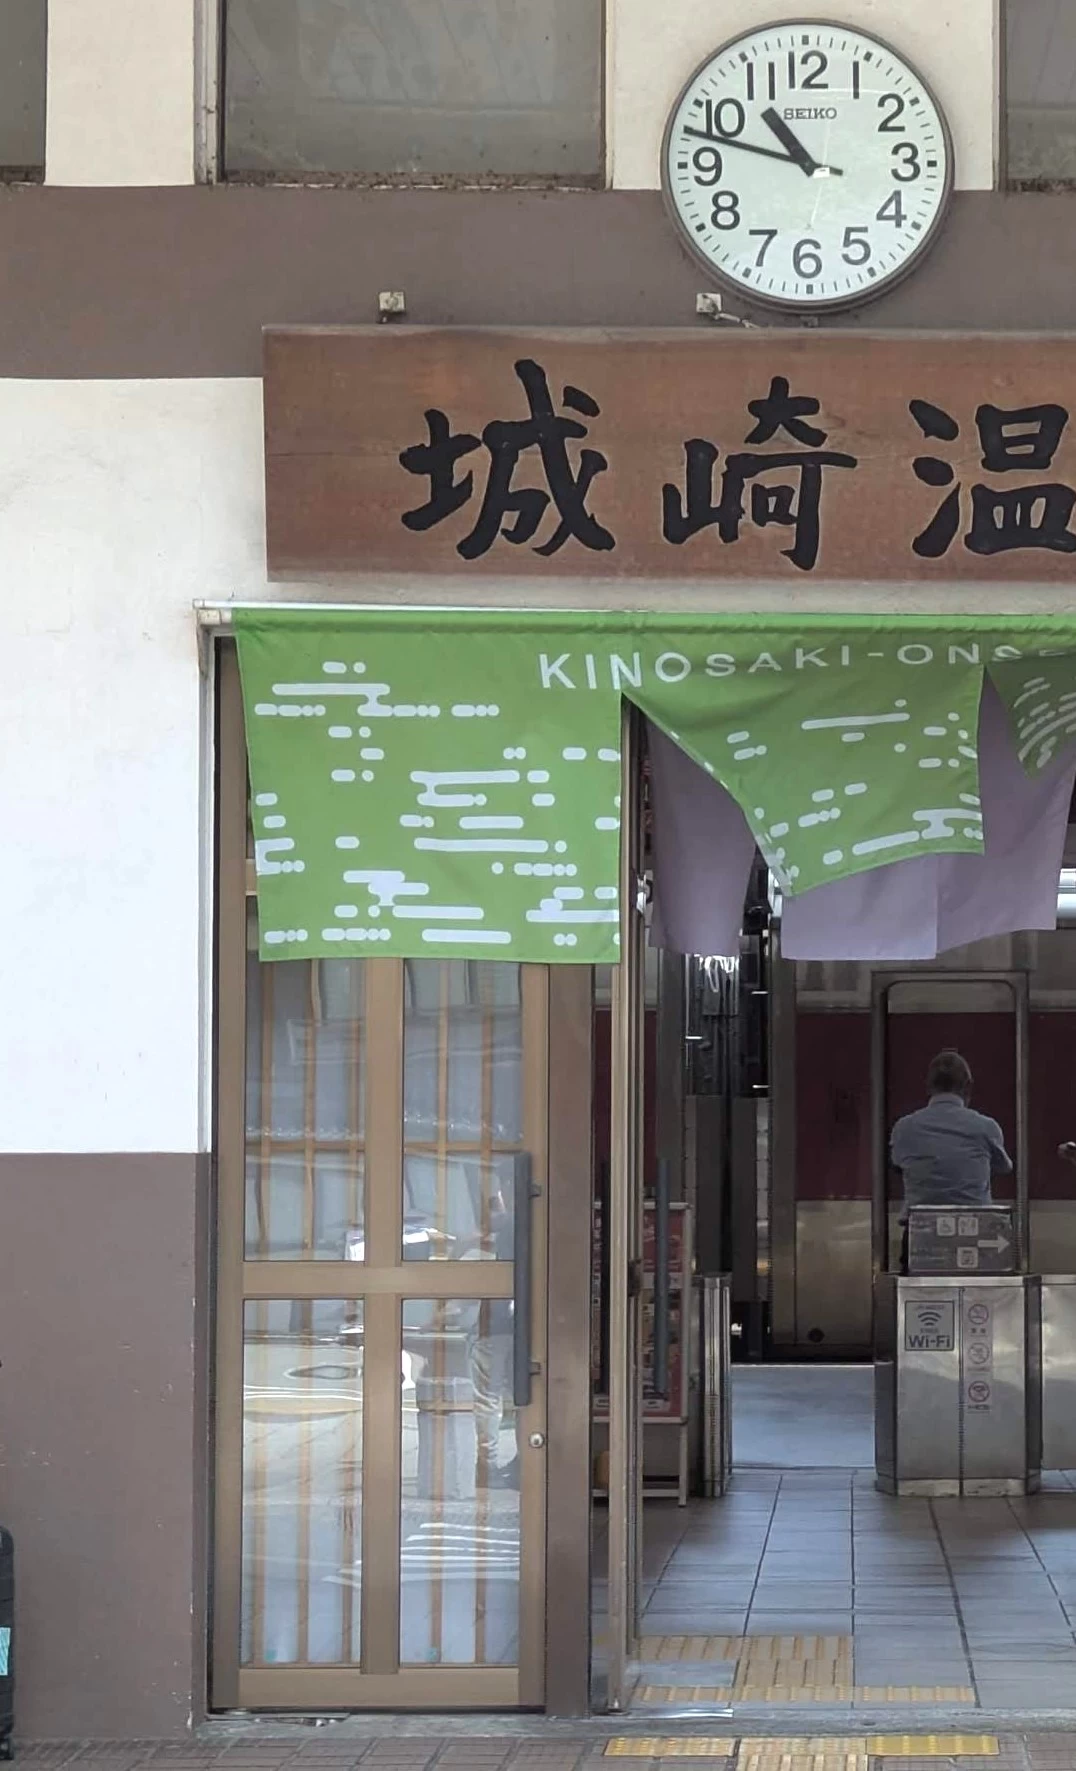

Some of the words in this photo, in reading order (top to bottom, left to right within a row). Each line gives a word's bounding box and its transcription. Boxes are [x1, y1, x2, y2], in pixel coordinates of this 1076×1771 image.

[747, 62, 775, 100] 11
[788, 50, 829, 90] 12
[852, 61, 860, 99] 1
[705, 97, 746, 138] 10
[783, 107, 837, 120] SEIKO
[877, 93, 906, 132] 2
[692, 146, 723, 186] 9
[890, 142, 921, 182] 3
[710, 190, 740, 230] 8
[876, 189, 907, 228] 4
[749, 229, 778, 267] 7
[792, 238, 823, 279] 6
[841, 226, 872, 265] 5
[908, 1334, 950, 1349] Wi-Fi
